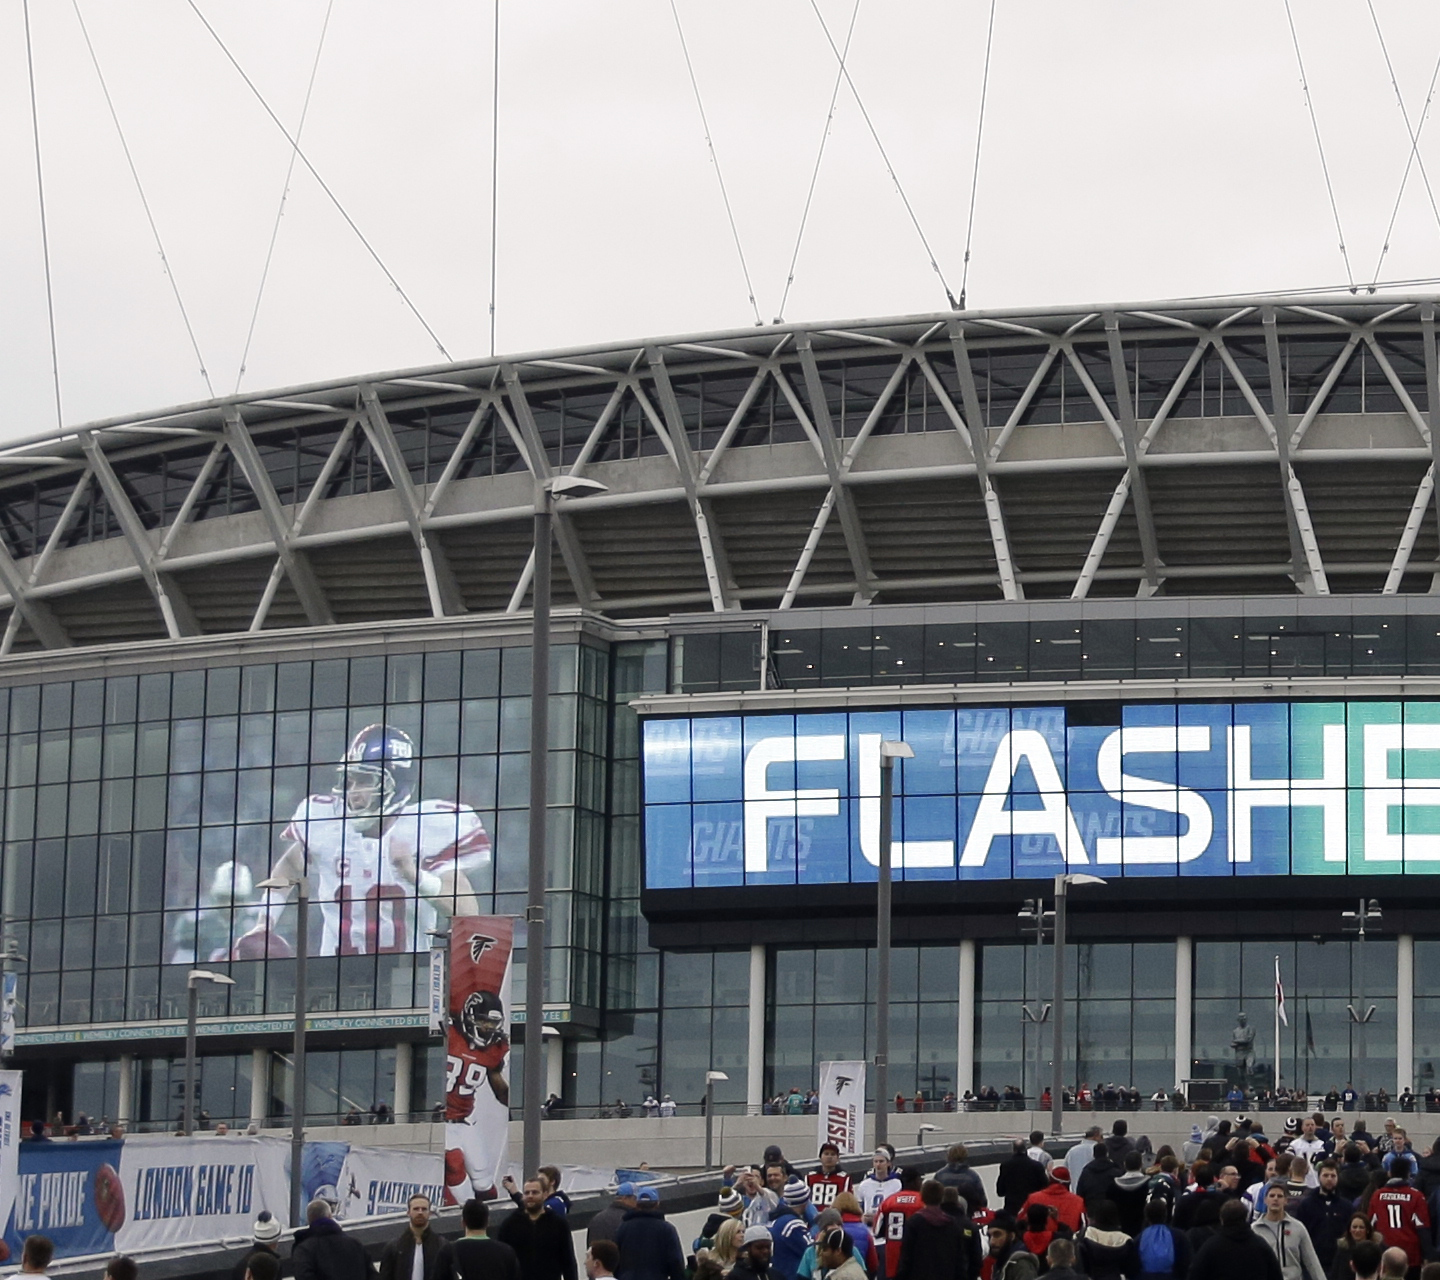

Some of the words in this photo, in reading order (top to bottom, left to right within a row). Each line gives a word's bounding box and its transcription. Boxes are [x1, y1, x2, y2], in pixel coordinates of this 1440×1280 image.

[686, 819, 815, 863] GIATS
[334, 884, 409, 955] 10
[83, 1029, 117, 1041] WEMBLEY
[119, 1027, 166, 1038] CONNECTED
[195, 1023, 232, 1034] WEMBLEY
[233, 1021, 281, 1032] CONNECTED
[282, 1020, 294, 1030] BY
[315, 1018, 357, 1029] WEMBLEY
[359, 1016, 406, 1028] CONNECTED
[407, 1016, 418, 1026] BY
[419, 1015, 430, 1025] EE
[827, 1104, 848, 1154] RISE
[15, 1172, 37, 1231] NE
[38, 1170, 89, 1230] PRIDE
[134, 1166, 193, 1221] LONDON
[194, 1164, 235, 1216] GAME
[236, 1164, 255, 1215] 10
[366, 1179, 378, 1216] 9
[811, 1183, 838, 1205] 88
[1387, 1204, 1402, 1229] 11
